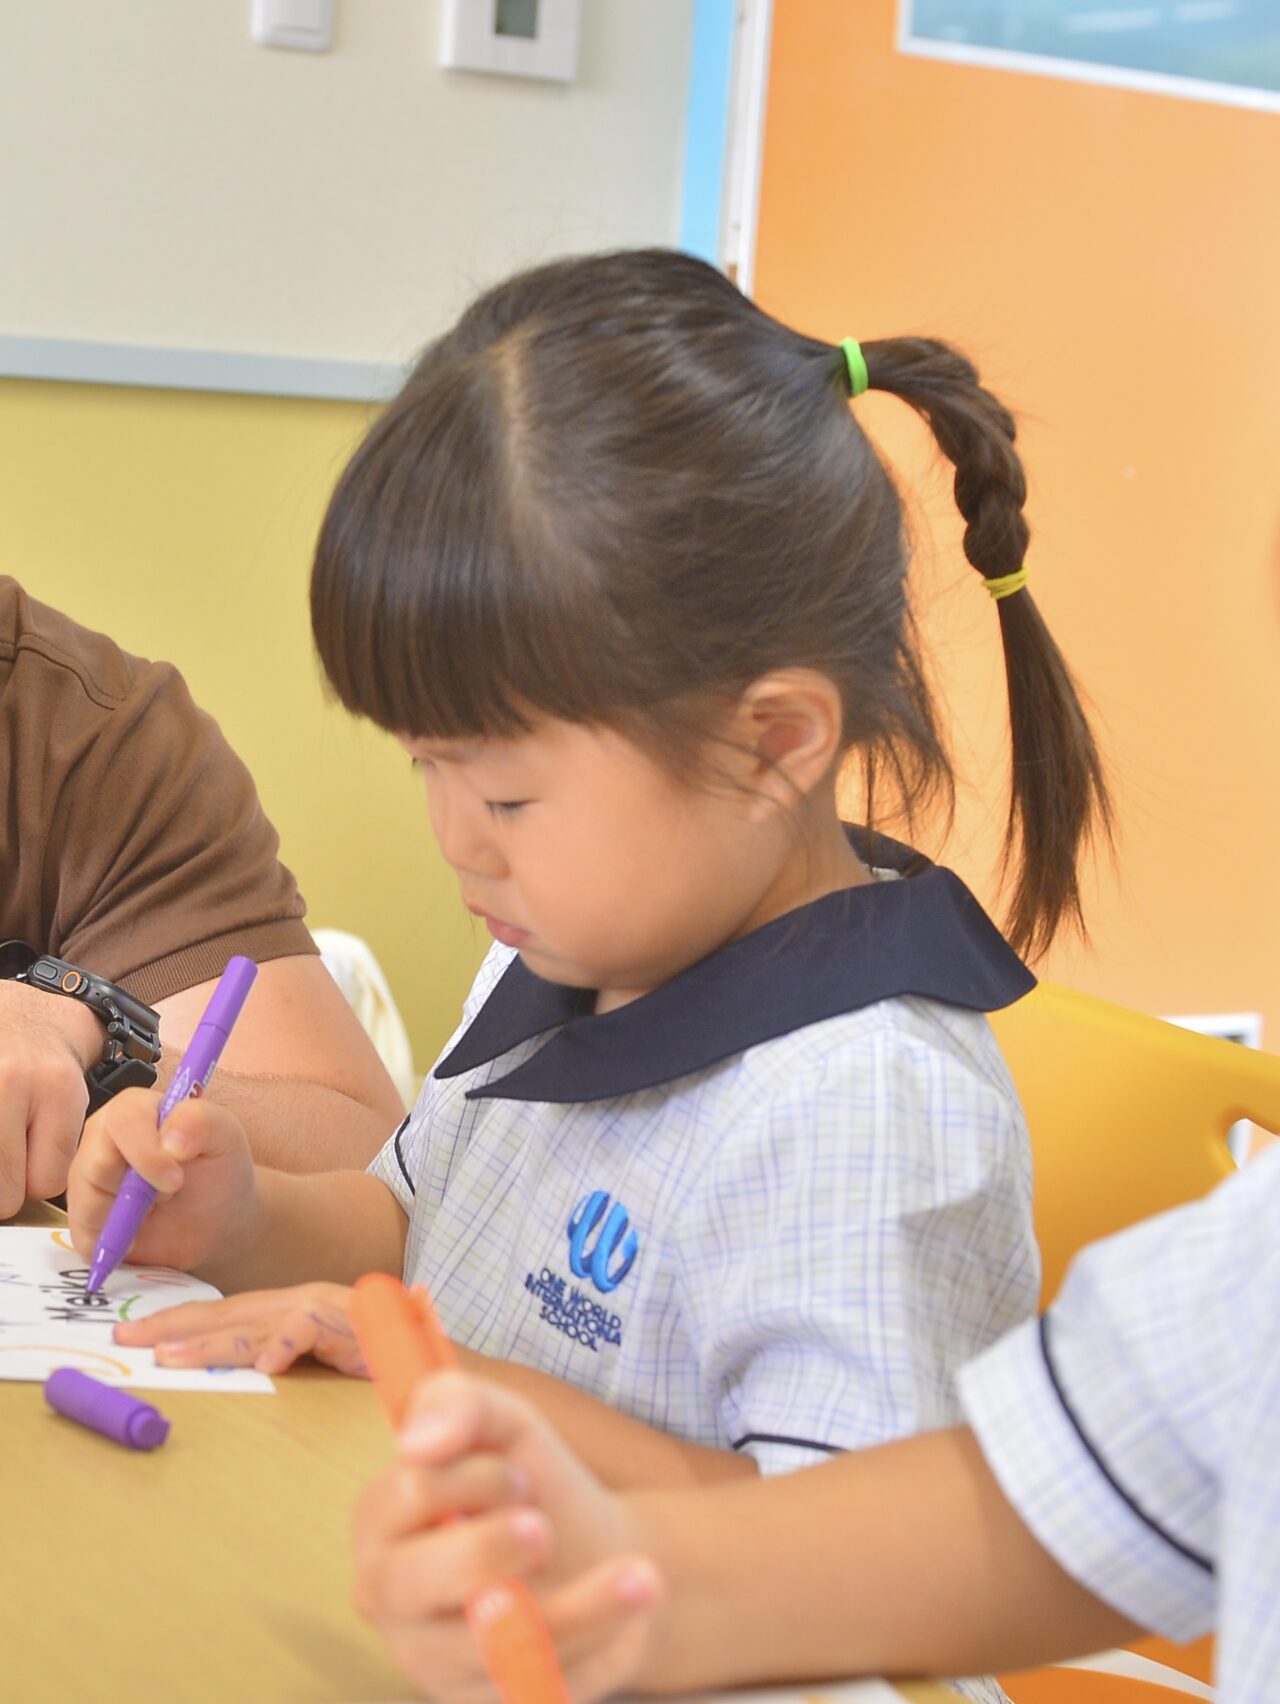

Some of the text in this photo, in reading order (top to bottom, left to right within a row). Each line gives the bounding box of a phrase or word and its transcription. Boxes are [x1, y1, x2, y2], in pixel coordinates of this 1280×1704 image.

[524, 1273, 621, 1346] INTERNATIONA
[539, 1306, 598, 1352] SCHOOL
[540, 1267, 621, 1330] ONE WORLD
